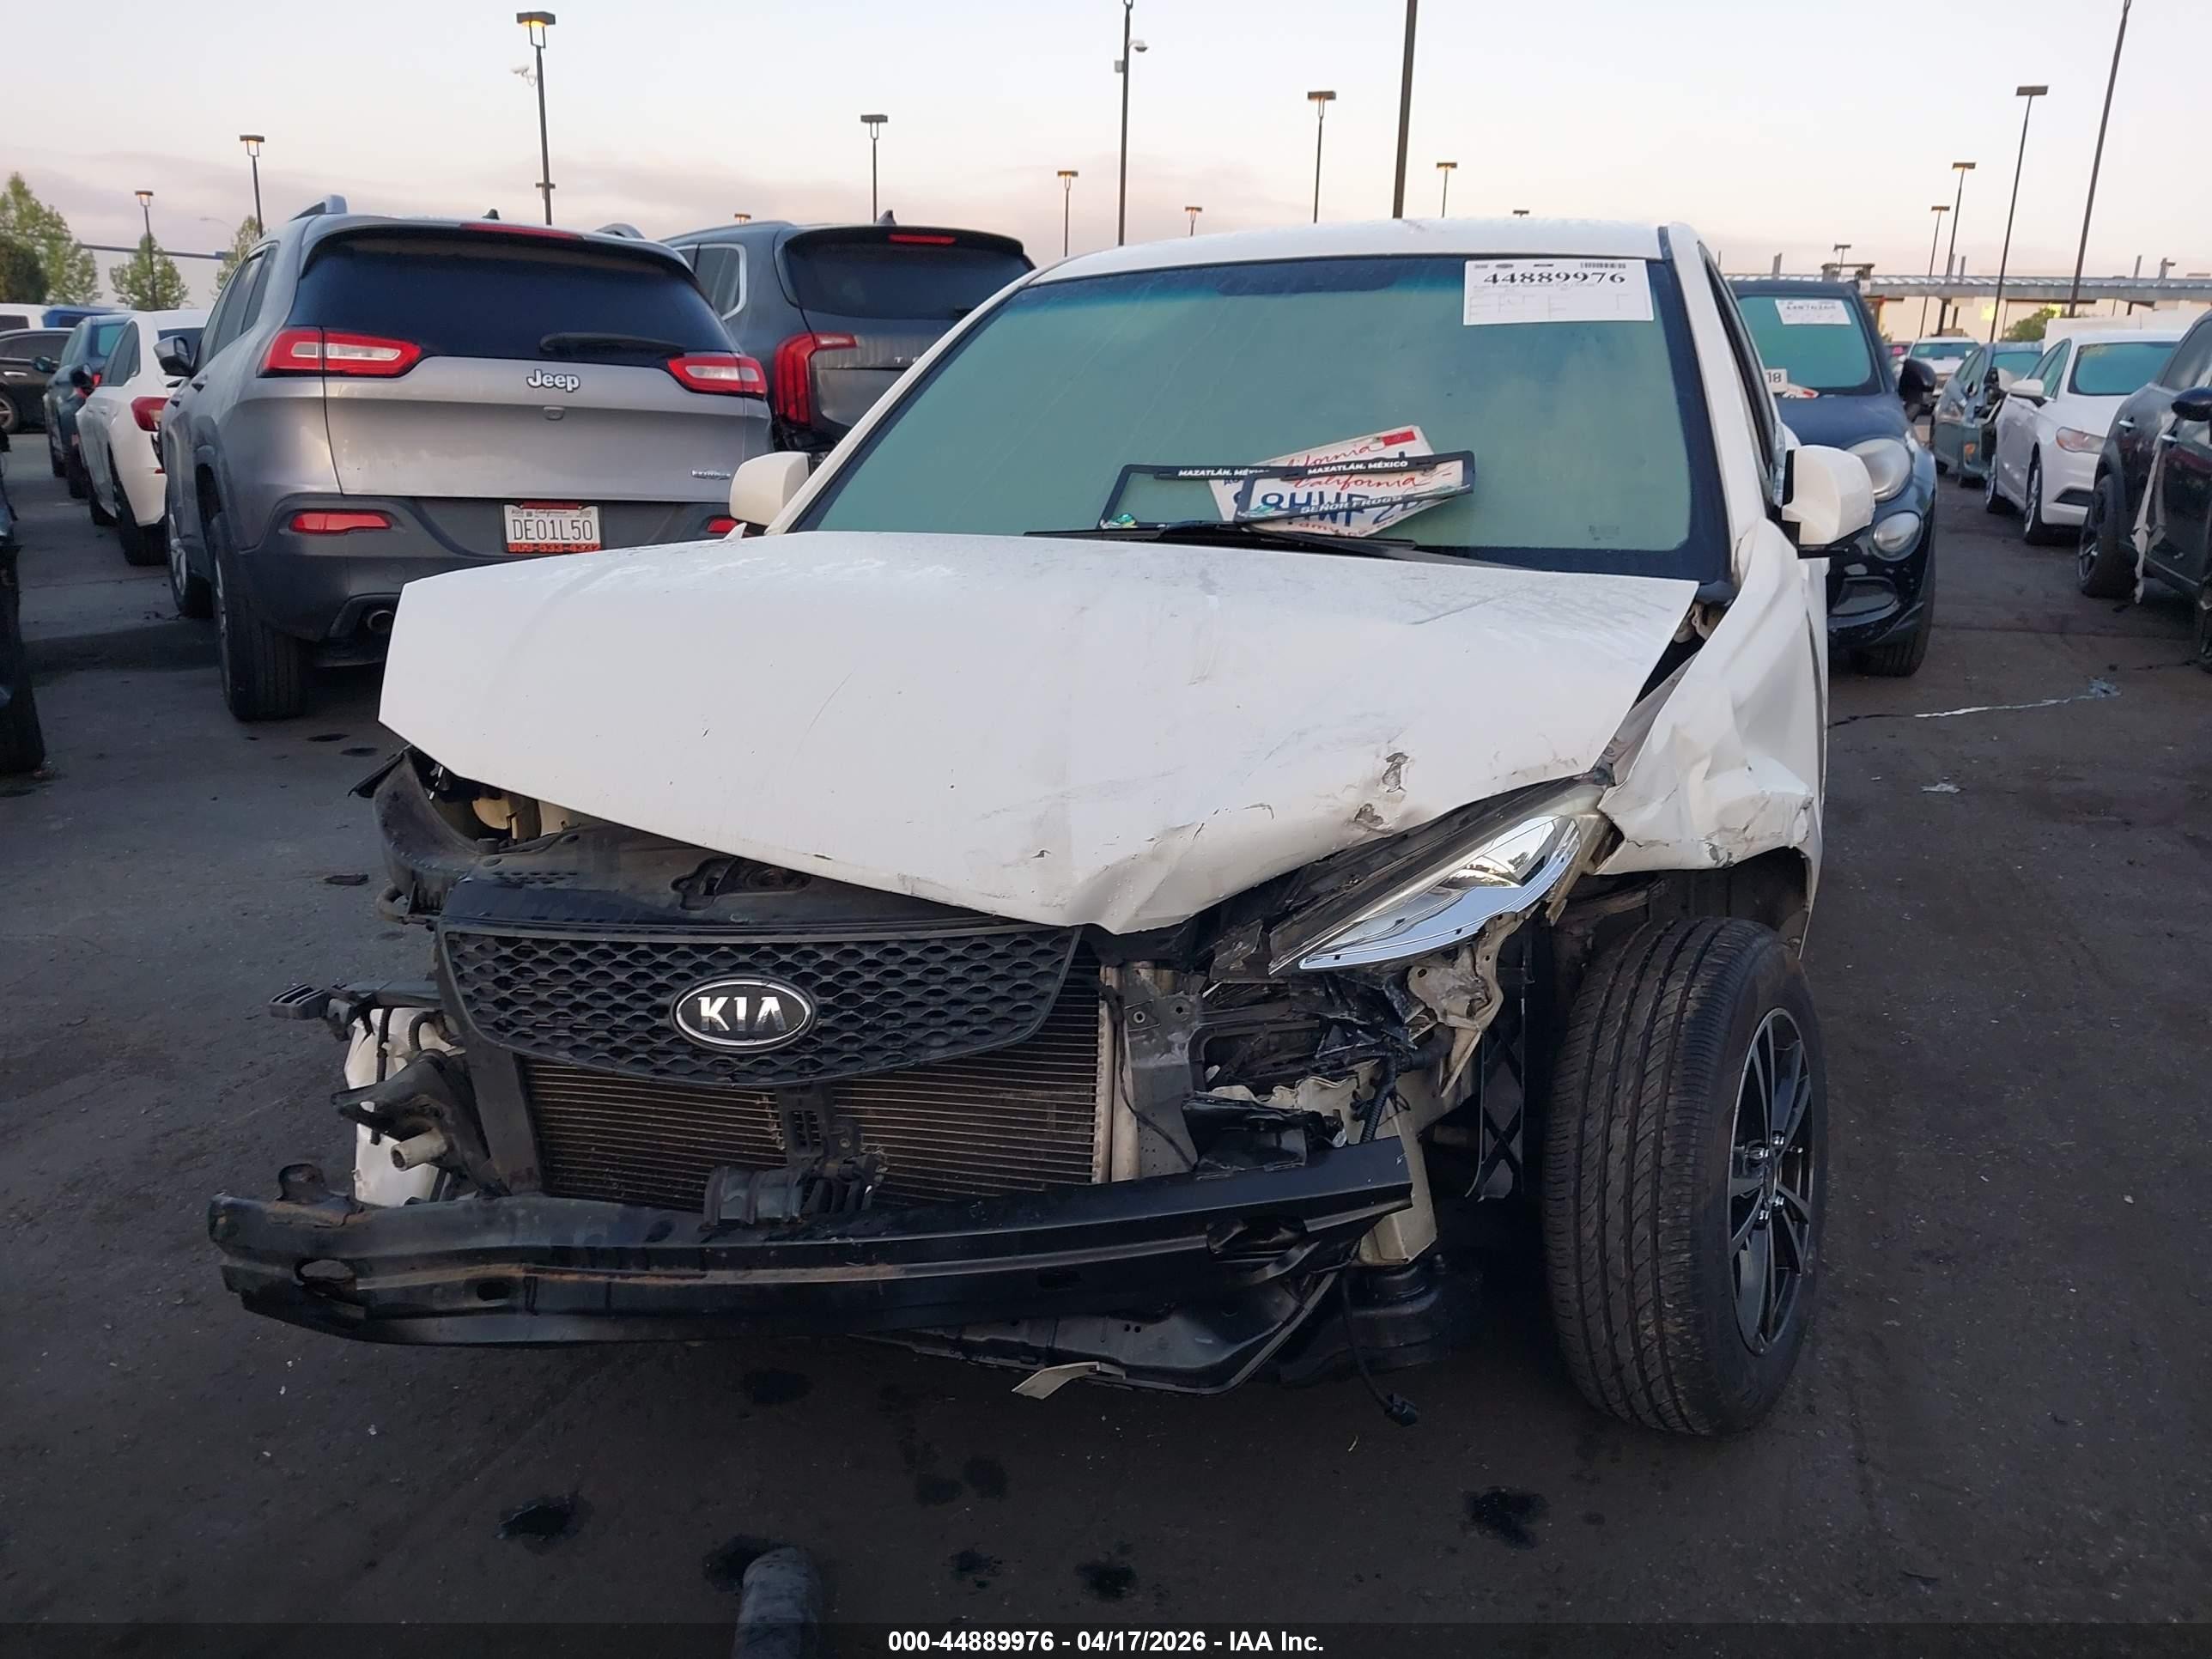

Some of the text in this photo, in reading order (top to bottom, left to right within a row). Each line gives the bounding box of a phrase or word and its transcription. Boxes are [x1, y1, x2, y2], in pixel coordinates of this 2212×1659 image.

[1483, 271, 1626, 284] 44889976
[526, 368, 580, 392] Jeep
[697, 996, 787, 1031] KIA
